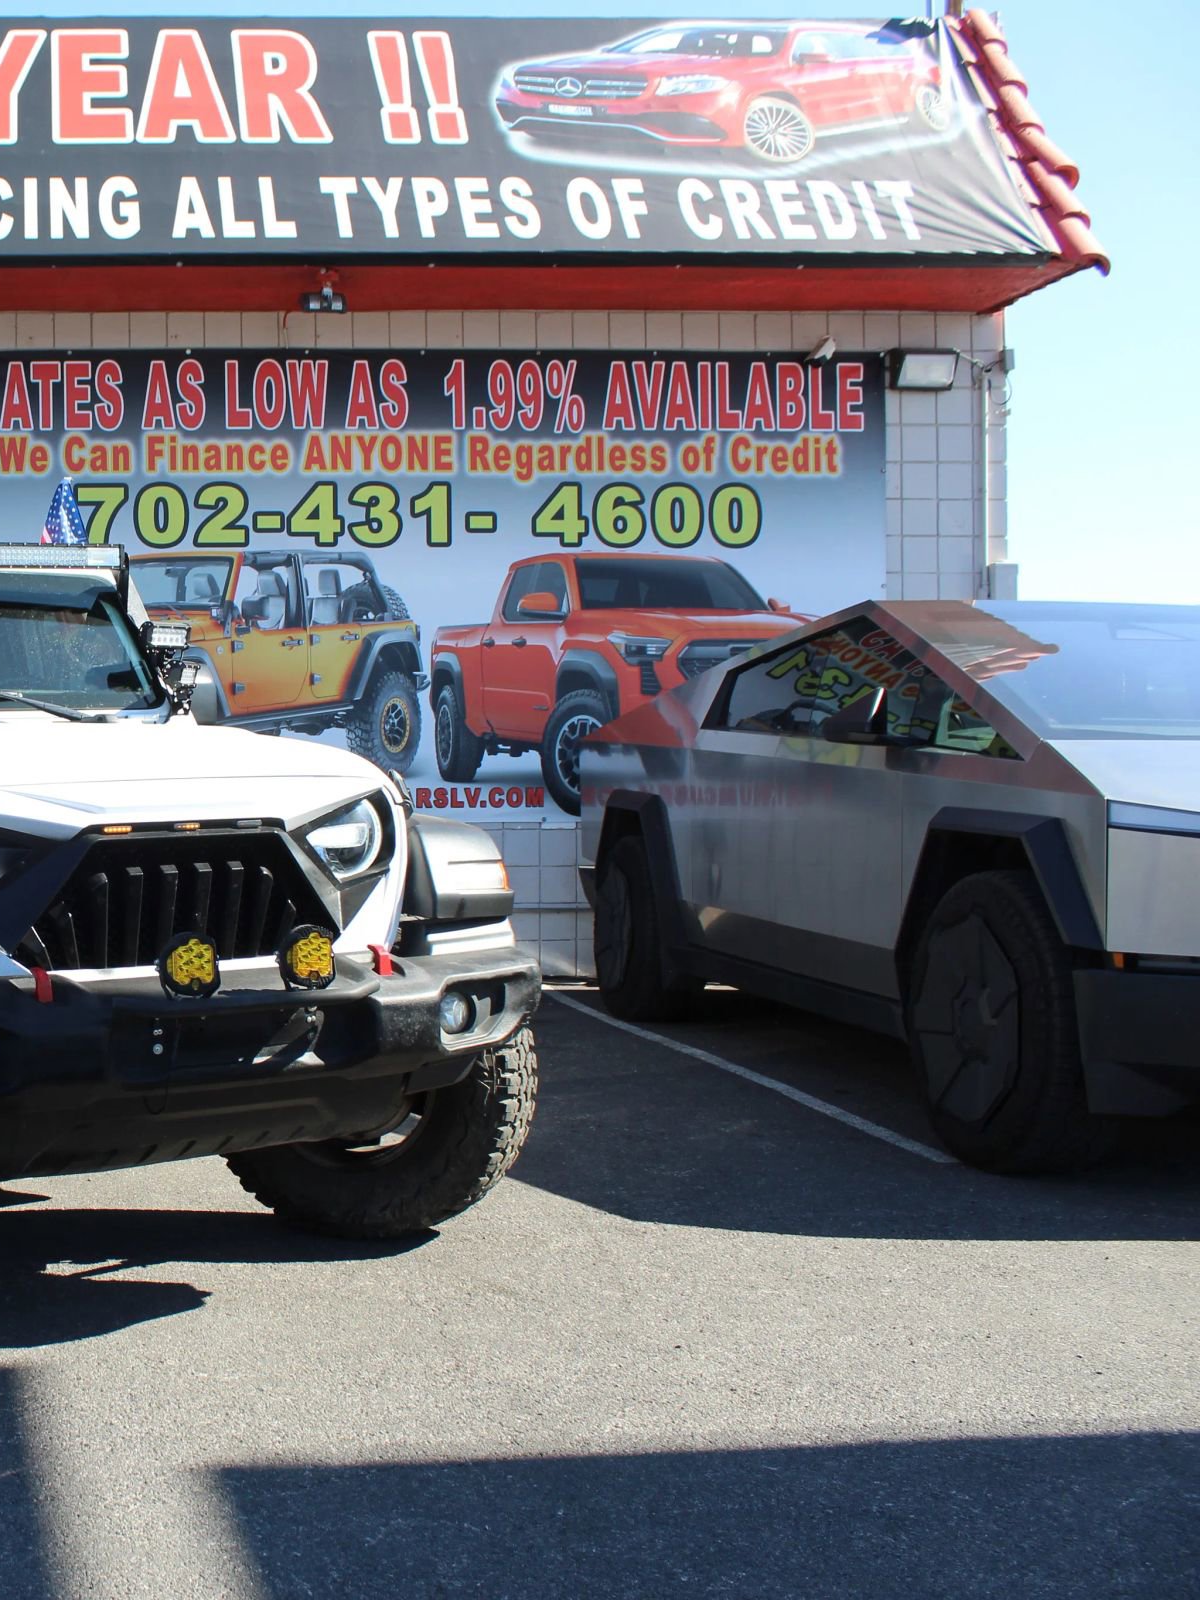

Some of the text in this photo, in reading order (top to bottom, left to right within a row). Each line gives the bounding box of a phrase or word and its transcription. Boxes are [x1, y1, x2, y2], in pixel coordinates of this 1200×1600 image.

[366, 29, 469, 145] !!
[171, 176, 298, 239] ALL
[320, 175, 543, 240] TYPES
[566, 176, 650, 240] OF
[676, 177, 923, 242] CREDIT
[141, 359, 206, 431] AS
[225, 358, 329, 430] LOW
[346, 358, 409, 430] AS
[443, 358, 586, 434] 1.99%
[602, 360, 865, 432] AVAILABLE
[63, 435, 131, 473] Can
[146, 434, 289, 472] Finance
[303, 434, 454, 472] ANYONE
[468, 434, 669, 482] Regardless
[681, 434, 717, 473] of
[730, 434, 839, 474] Credit
[531, 481, 763, 549] 4600
[415, 786, 546, 809] RSLV.COM
